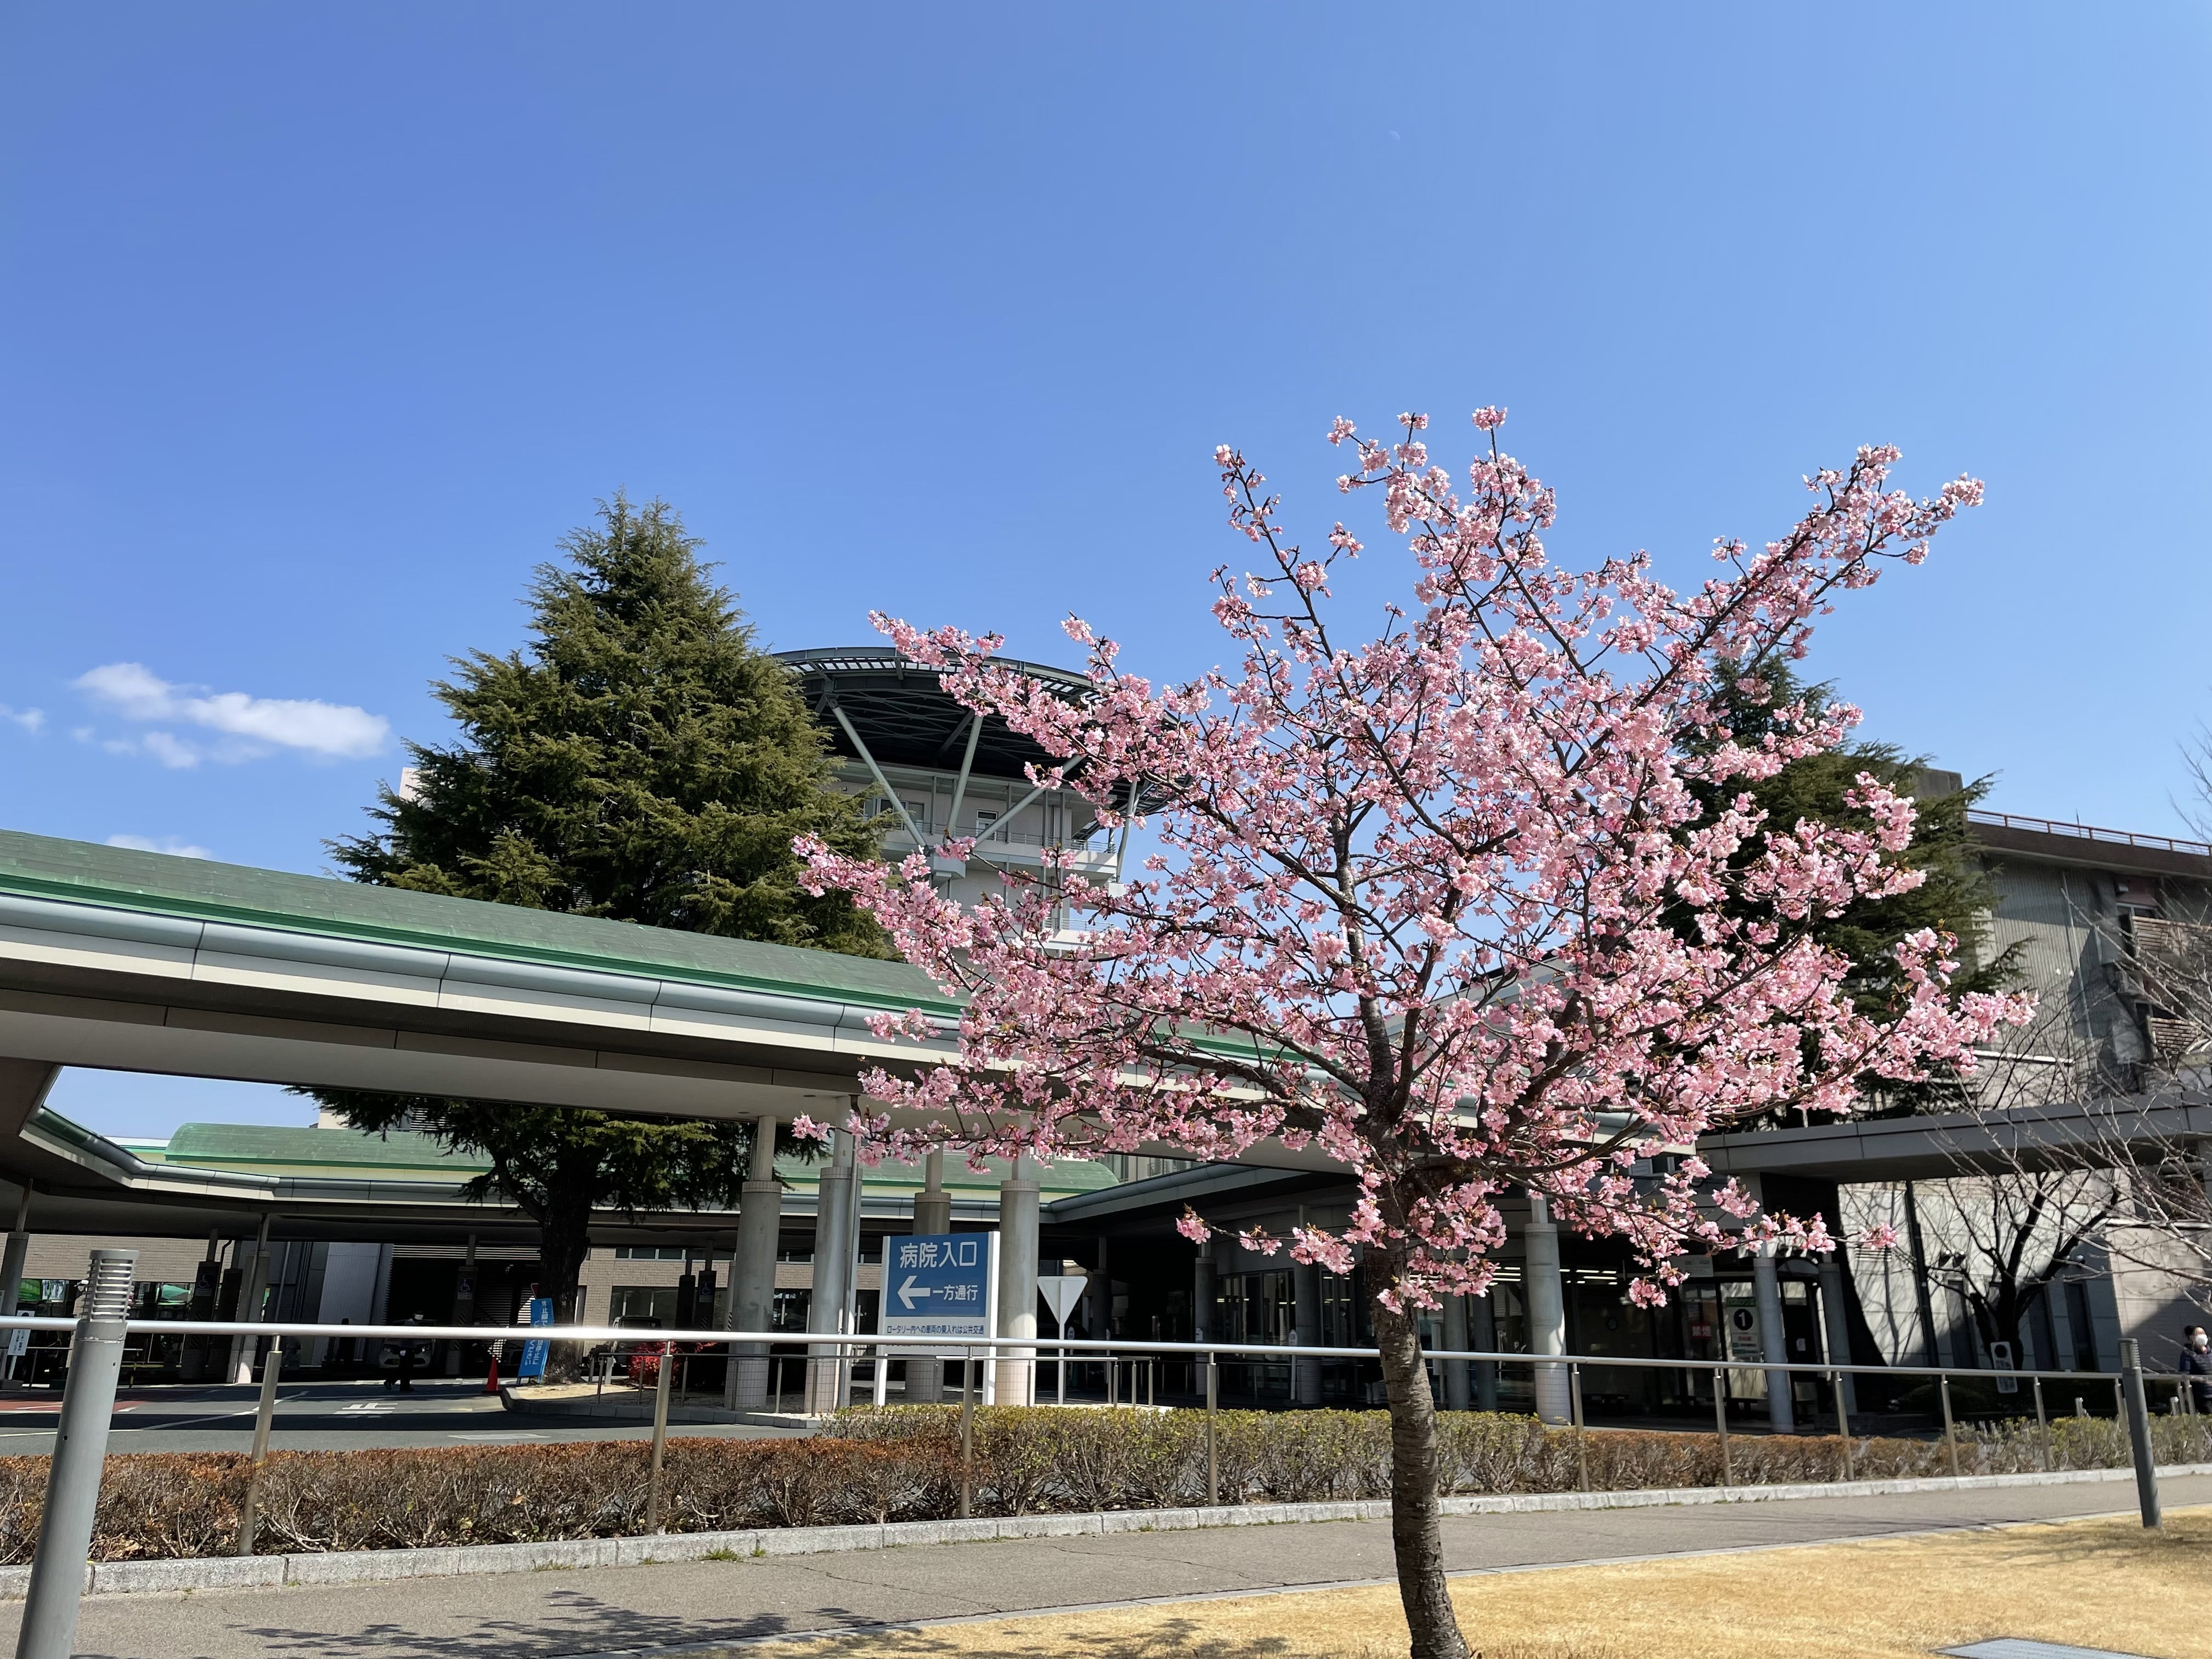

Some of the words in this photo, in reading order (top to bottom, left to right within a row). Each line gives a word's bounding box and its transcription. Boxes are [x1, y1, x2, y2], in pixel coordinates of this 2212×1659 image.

[900, 1241, 977, 1268] 病院入口
[933, 1284, 978, 1301] 一方通行
[1738, 1312, 1746, 1327] 1
